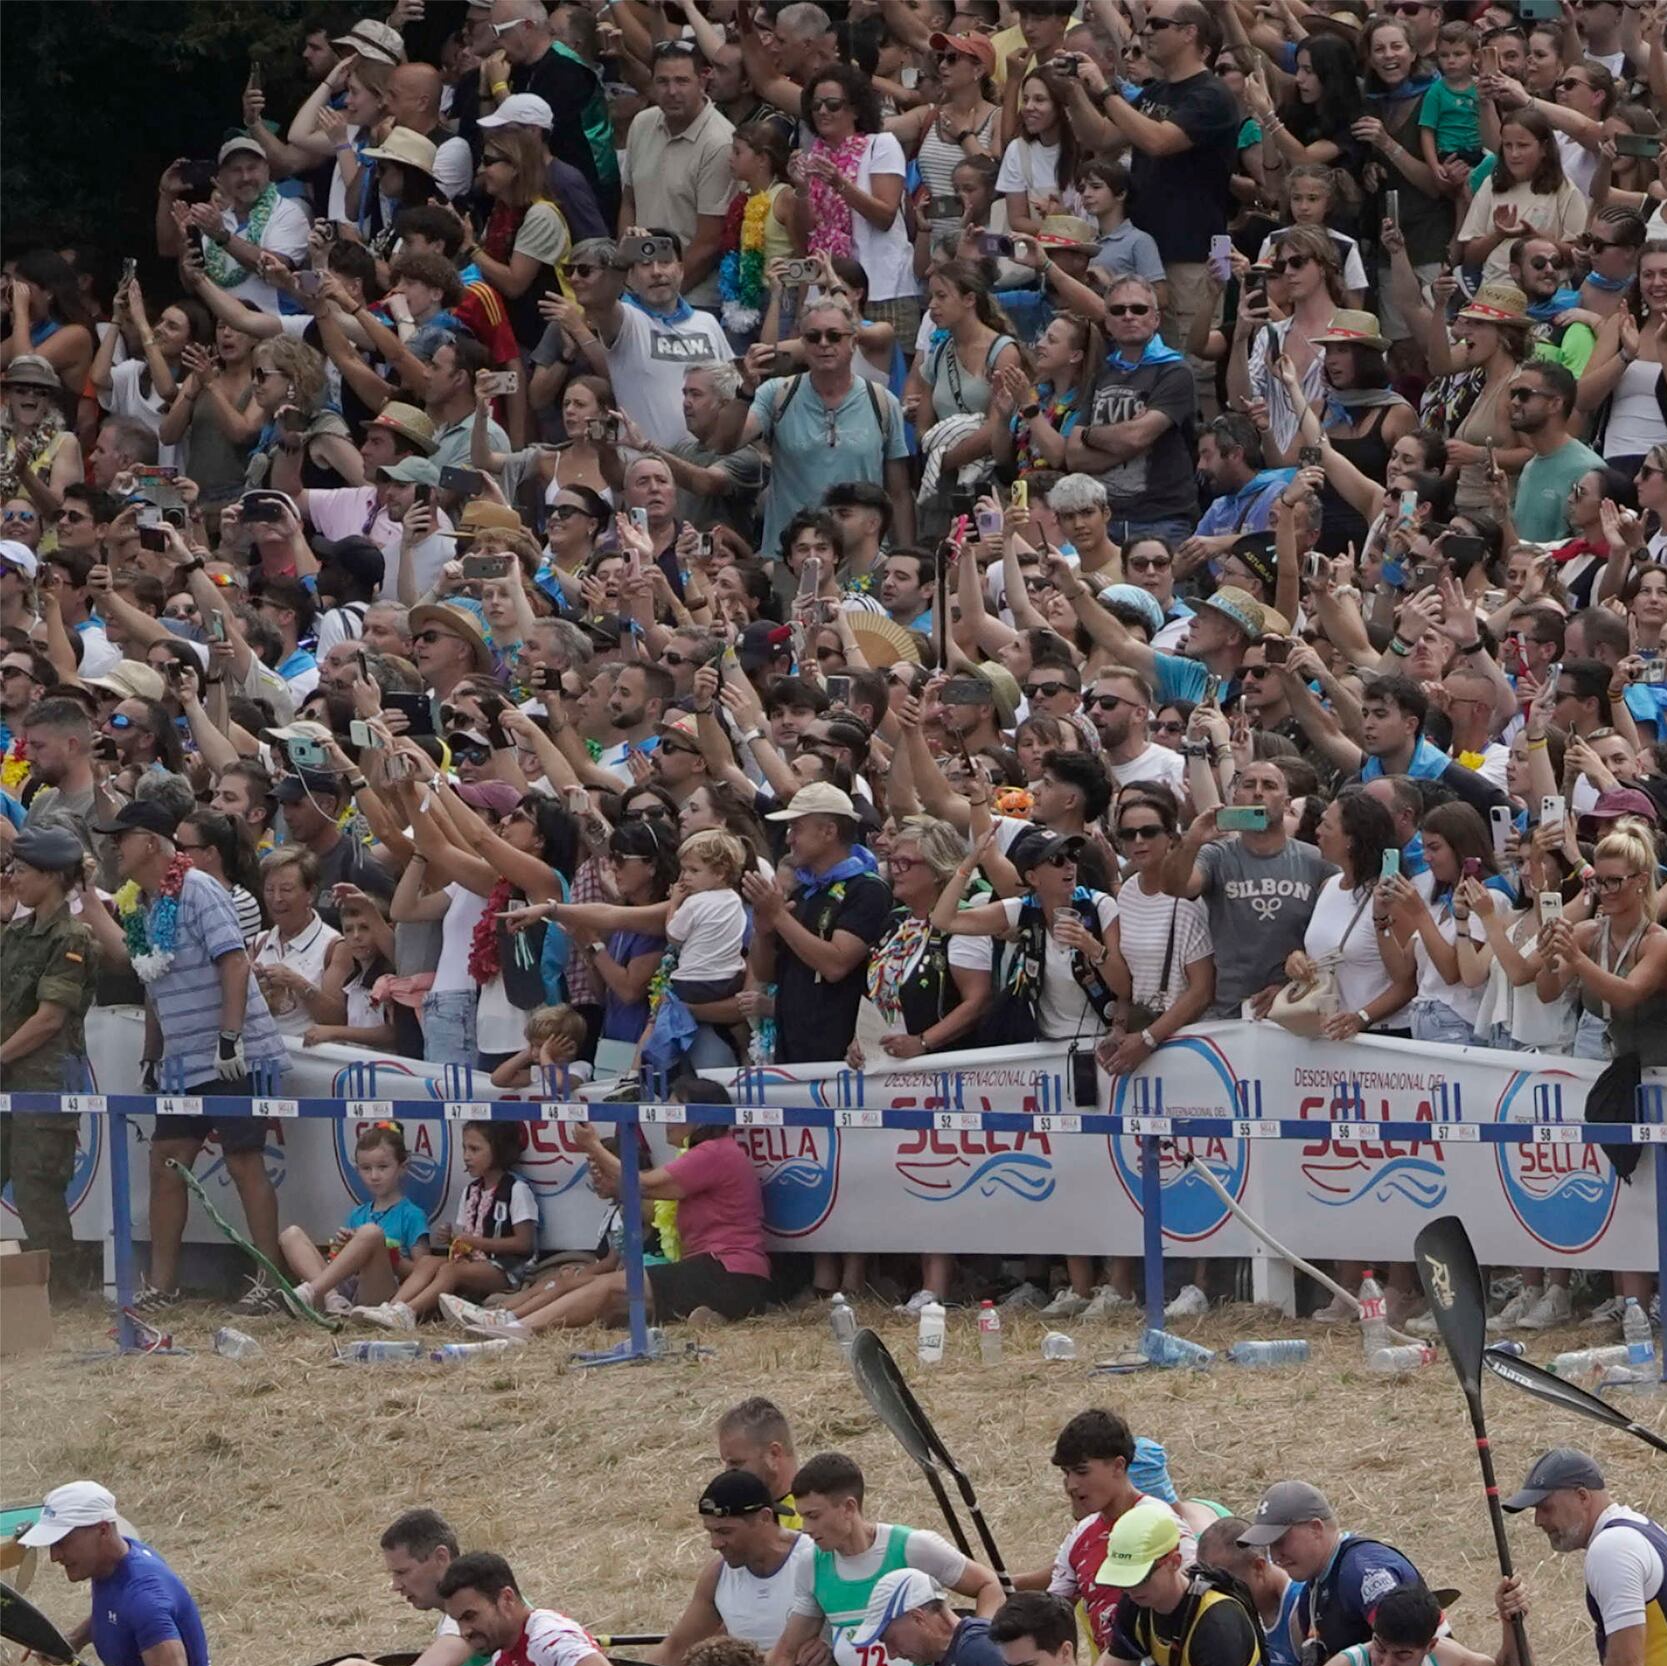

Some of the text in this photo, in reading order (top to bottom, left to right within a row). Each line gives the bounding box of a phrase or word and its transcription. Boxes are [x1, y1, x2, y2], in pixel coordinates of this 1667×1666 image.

[656, 337, 709, 356] RAW.
[1225, 878, 1313, 902] SILBON
[1295, 1068, 1351, 1088] DESCENSO
[68, 1098, 78, 1110] 43
[163, 1099, 173, 1112] 44
[259, 1103, 269, 1115] 45
[353, 1104, 363, 1116] 46
[452, 1105, 462, 1118] 47
[549, 1106, 559, 1118] 48
[646, 1109, 656, 1121] 49
[743, 1111, 753, 1123] 50
[842, 1113, 852, 1125] 51
[941, 1116, 951, 1128] 52
[1041, 1118, 1051, 1130] 53
[896, 1096, 1050, 1156] SELLA
[1130, 1119, 1140, 1132] 54
[1240, 1122, 1250, 1135] 55
[1300, 1097, 1444, 1162] SELLA
[1339, 1125, 1350, 1137] 56
[1439, 1127, 1449, 1139] 57
[1541, 1128, 1551, 1140] 58
[1640, 1128, 1650, 1140] 59
[732, 1127, 819, 1163] SELLA
[1519, 1142, 1599, 1174] SELLA
[1111, 1551, 1132, 1561] icon
